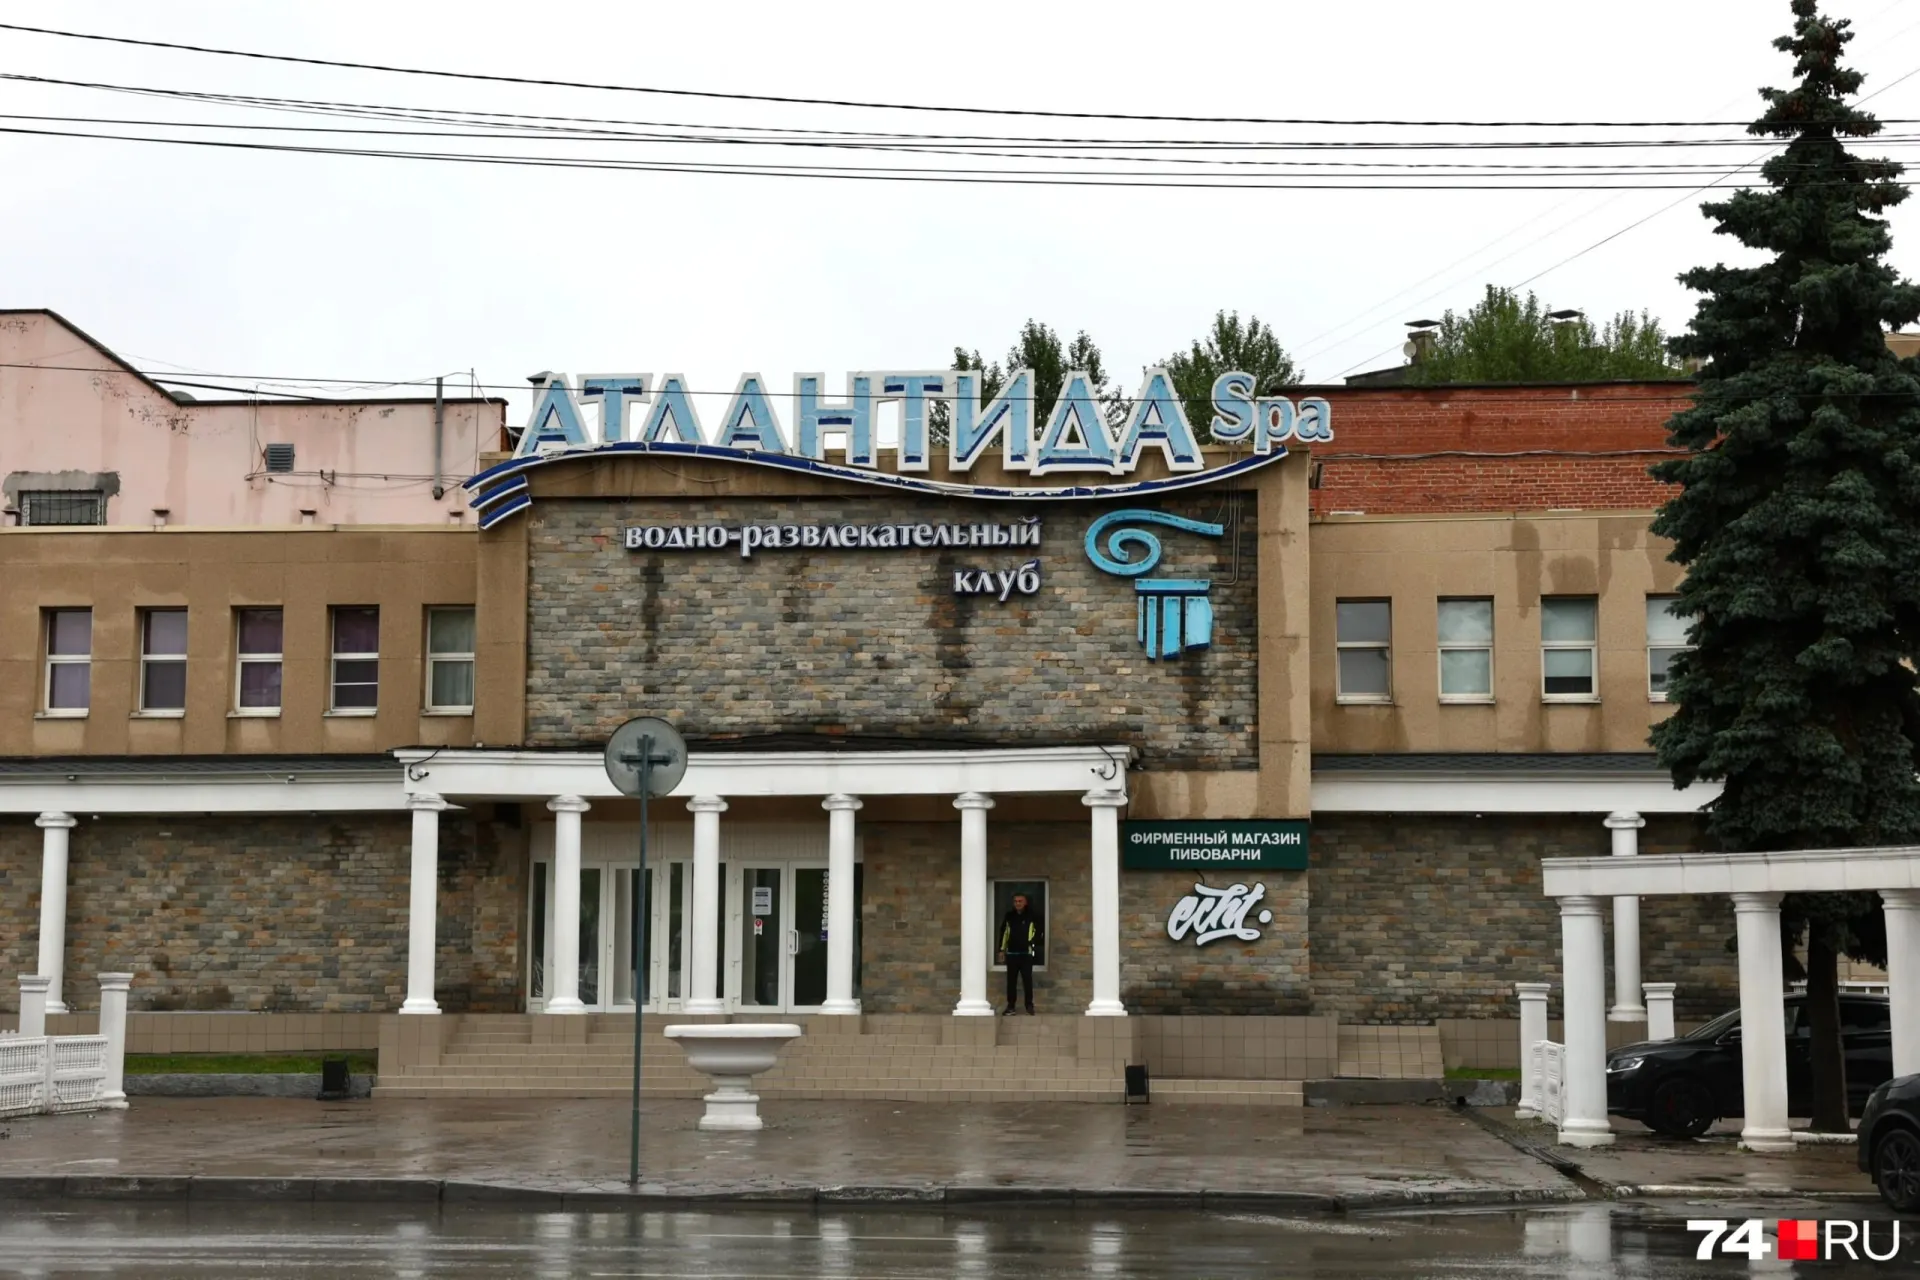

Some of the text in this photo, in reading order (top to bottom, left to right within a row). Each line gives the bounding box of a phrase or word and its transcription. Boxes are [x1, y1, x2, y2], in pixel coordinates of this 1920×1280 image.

[511, 367, 1334, 476] АТЛАНТИДА Spa
[623, 515, 1042, 557] водно-развлекательный
[952, 559, 1042, 602] клуб
[1130, 830, 1301, 845] ФИРМЕННЫЙ МАГАЗИН
[1169, 848, 1261, 861] ПИВОВАРНИ
